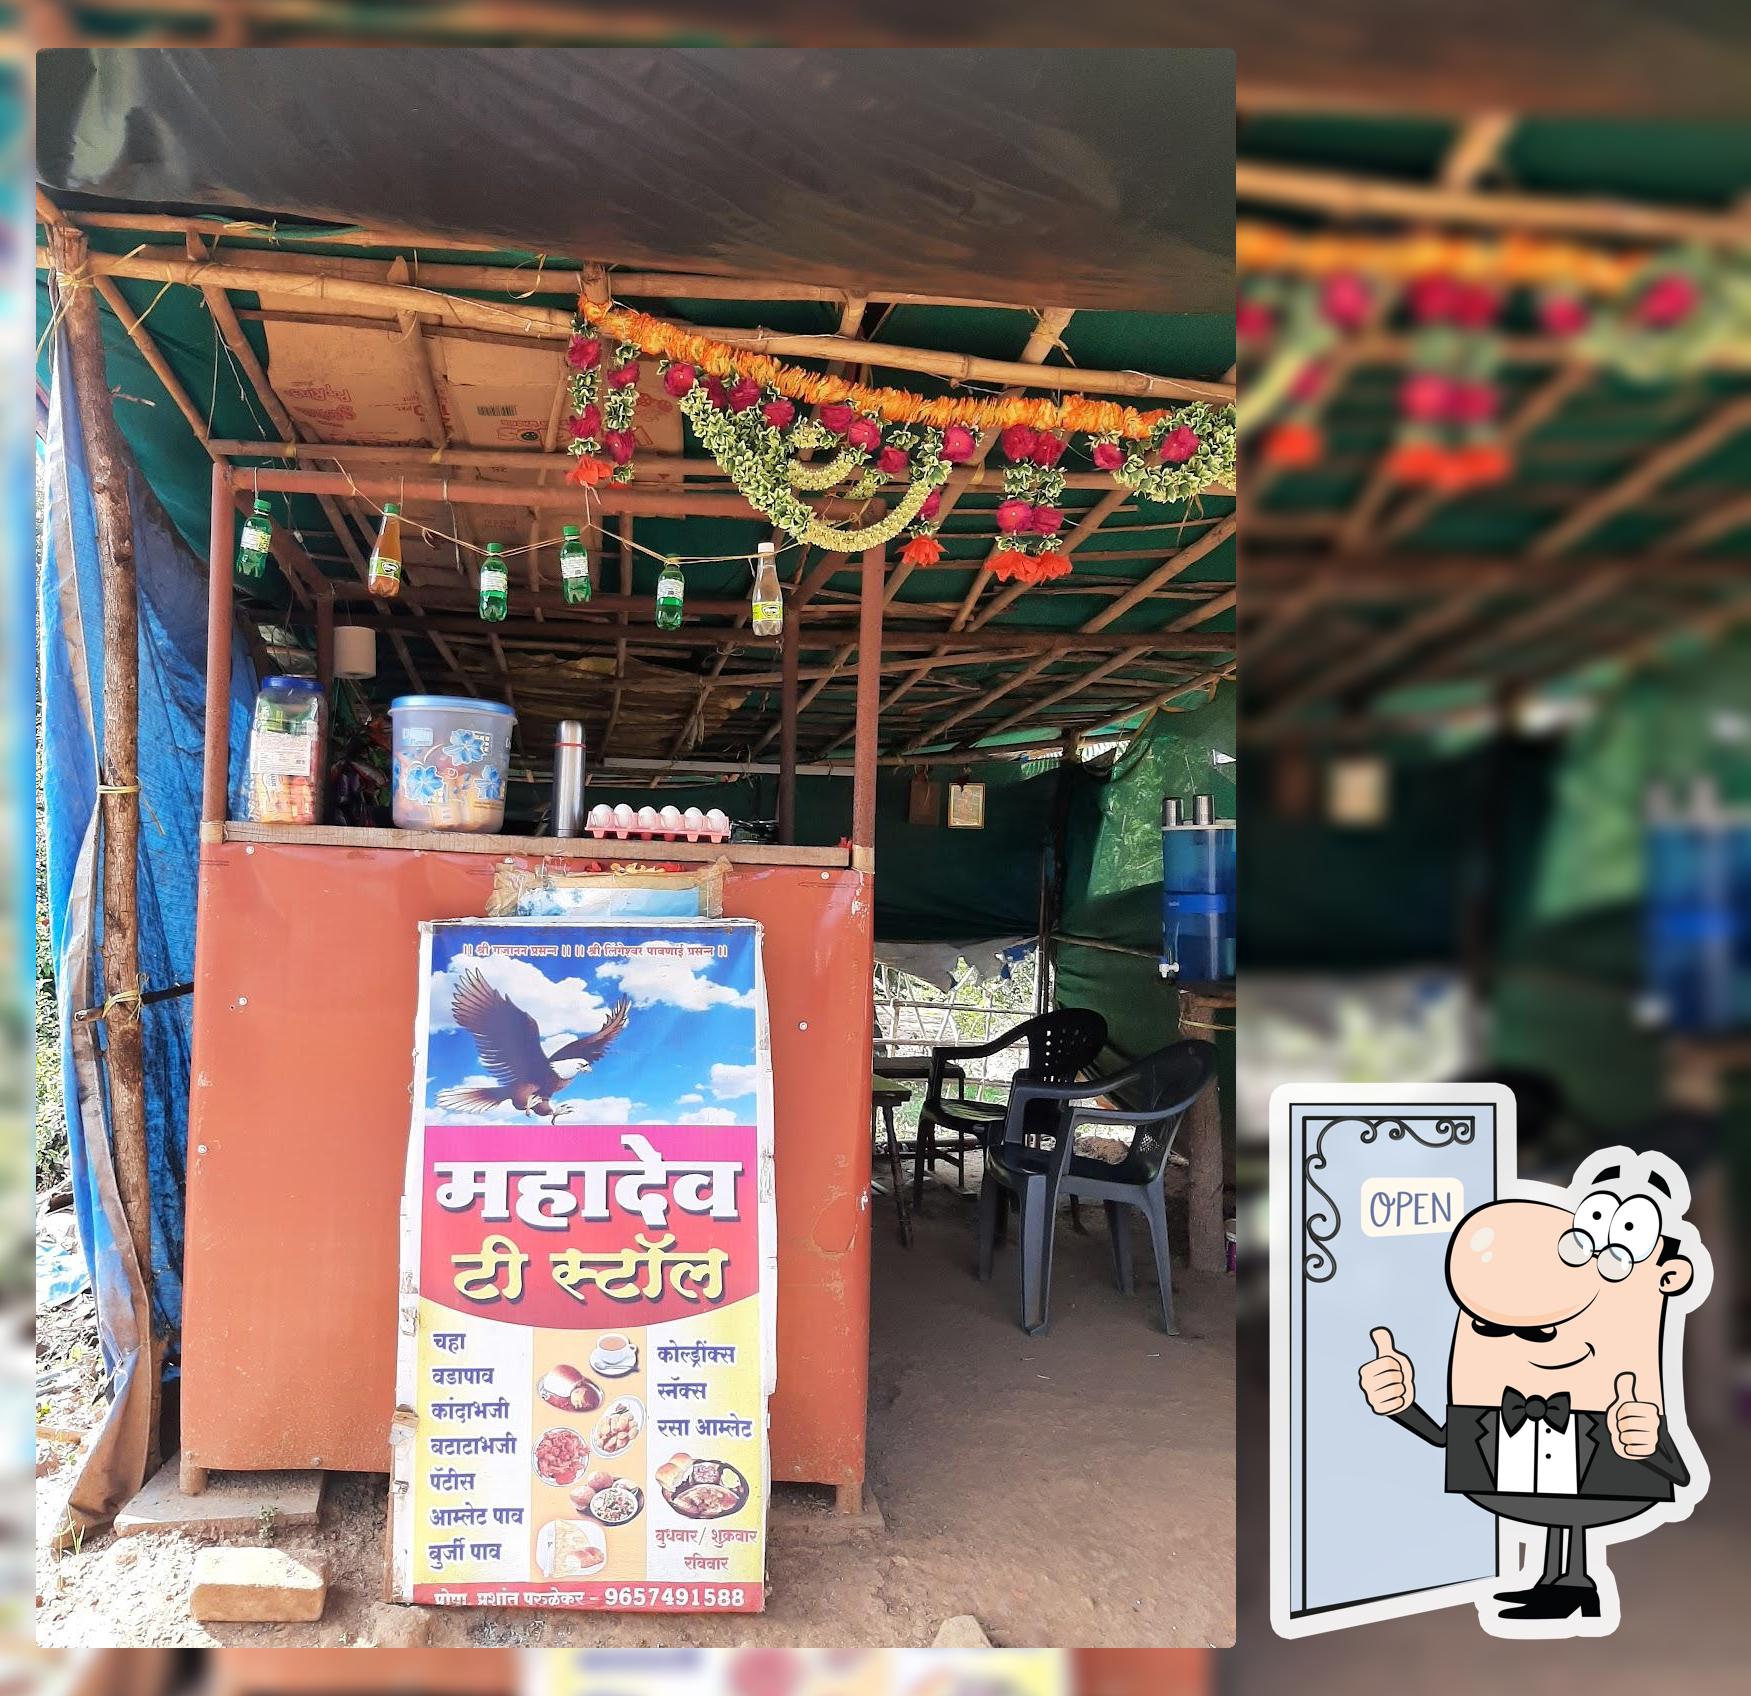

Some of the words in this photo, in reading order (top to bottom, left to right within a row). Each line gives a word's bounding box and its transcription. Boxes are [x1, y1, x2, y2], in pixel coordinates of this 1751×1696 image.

[476, 942, 490, 957] श्री
[588, 942, 601, 957] श्री
[433, 1134, 743, 1228] महादेव
[451, 1234, 529, 1300] टी
[549, 1233, 729, 1302] स्टॉल
[432, 1333, 466, 1354] चहा
[431, 1367, 495, 1385] वडापाव
[656, 1376, 708, 1400] स्नॅक्स
[431, 1396, 510, 1423] कांदाभजी
[656, 1419, 690, 1438] रसा
[696, 1412, 752, 1438] आम्लेट
[430, 1431, 517, 1456] बटाटाभजी
[429, 1467, 476, 1491] पॅटीस
[430, 1501, 488, 1526] आम्लेट
[492, 1507, 525, 1525] पाव
[470, 1543, 502, 1560] पाव
[683, 1553, 729, 1570] रविवार
[604, 1587, 745, 1607] 9657491588
